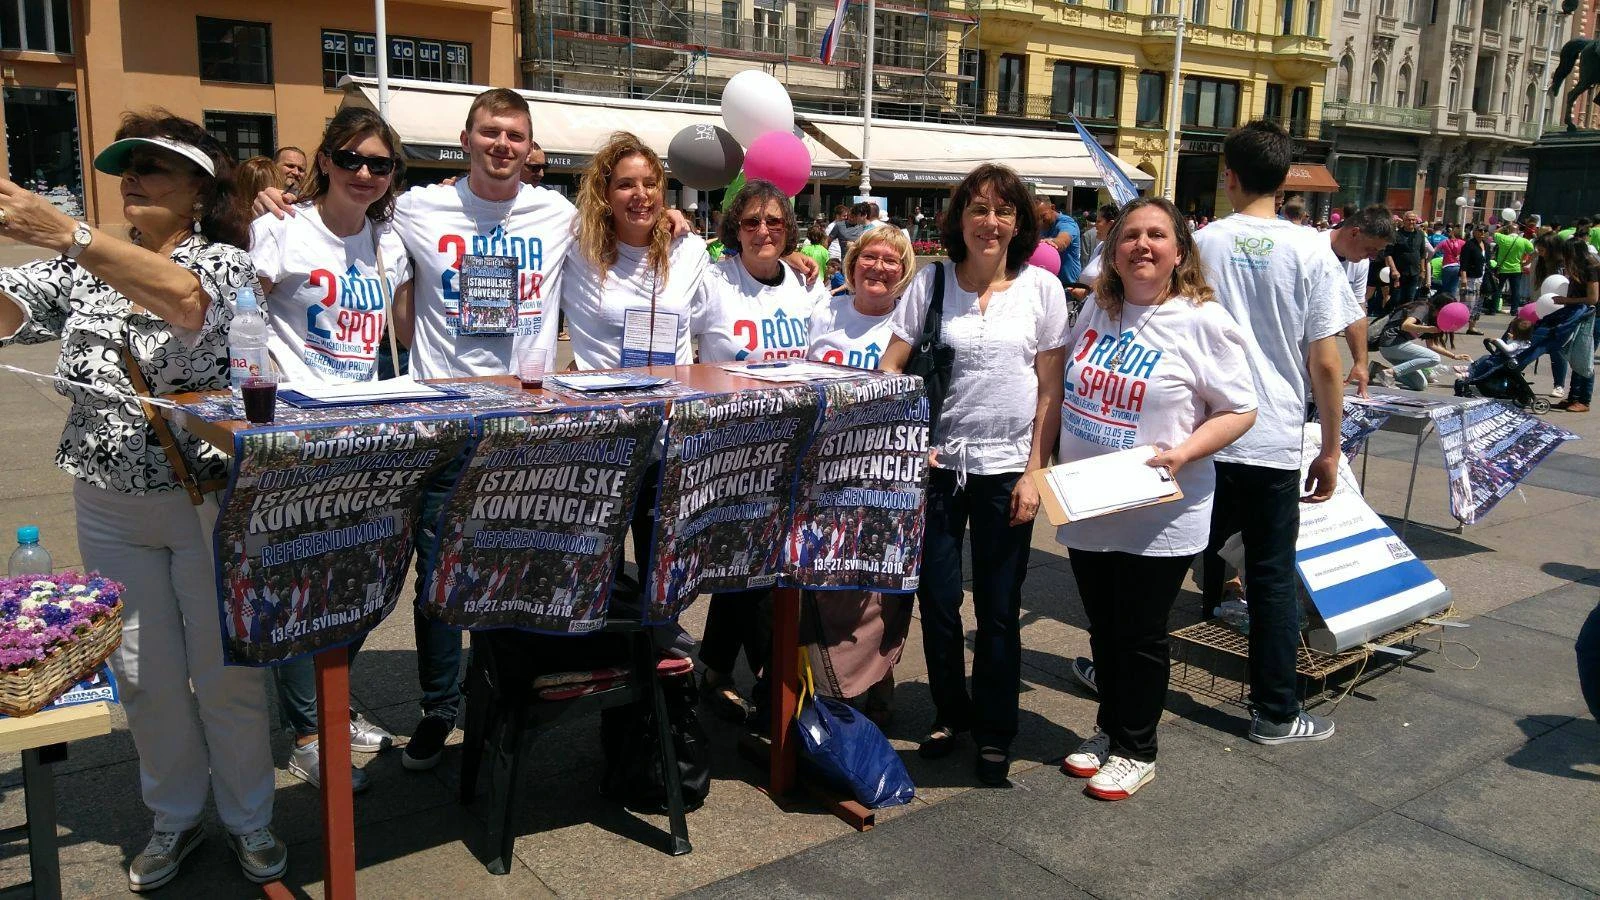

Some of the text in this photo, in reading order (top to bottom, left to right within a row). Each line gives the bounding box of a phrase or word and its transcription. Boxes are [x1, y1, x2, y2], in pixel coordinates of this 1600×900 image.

[547, 157, 571, 165] WATER
[1234, 235, 1274, 250] HOD
[467, 277, 512, 288] ISTANBULSKE
[468, 287, 510, 298] KONVENCIJE
[856, 376, 917, 403] POTPISITE ZA
[1078, 366, 1147, 412] SPOLA
[708, 396, 784, 425] POTPISITE ZA
[527, 418, 620, 442] POTPISITE ZA
[681, 417, 801, 463] OTKAZIVANJE
[817, 425, 929, 457] ISTANBULSKE
[1081, 417, 1102, 435] PROTIV
[1104, 425, 1122, 438] 13.05
[302, 432, 416, 462] POTPISITE ZA
[485, 437, 637, 470] OTKAZIVANJE
[1102, 436, 1121, 449] 27.05
[257, 448, 440, 492] OTKAZIVANJE
[678, 442, 790, 491] ISTANBULSKE
[816, 455, 924, 485] KONVENCIJE
[250, 470, 426, 513] ISTANBULSKE
[475, 465, 627, 498] ISTANBULSKE
[679, 467, 778, 521] KONVENCIJE
[249, 488, 404, 535] KONVENCIJE
[471, 494, 614, 529] KONVENCIJE
[816, 488, 916, 511] REFERENDUMOM!
[261, 516, 395, 568] REFERENDUMOM!
[473, 530, 598, 555] REFERENDUMOM!
[727, 564, 751, 577] 2018.
[845, 558, 880, 573] SVIBNJA
[881, 561, 906, 575] 2018.
[312, 608, 361, 630] SVIBNJA
[500, 600, 544, 616] SVIBNJA
[546, 603, 575, 619] 2018.
